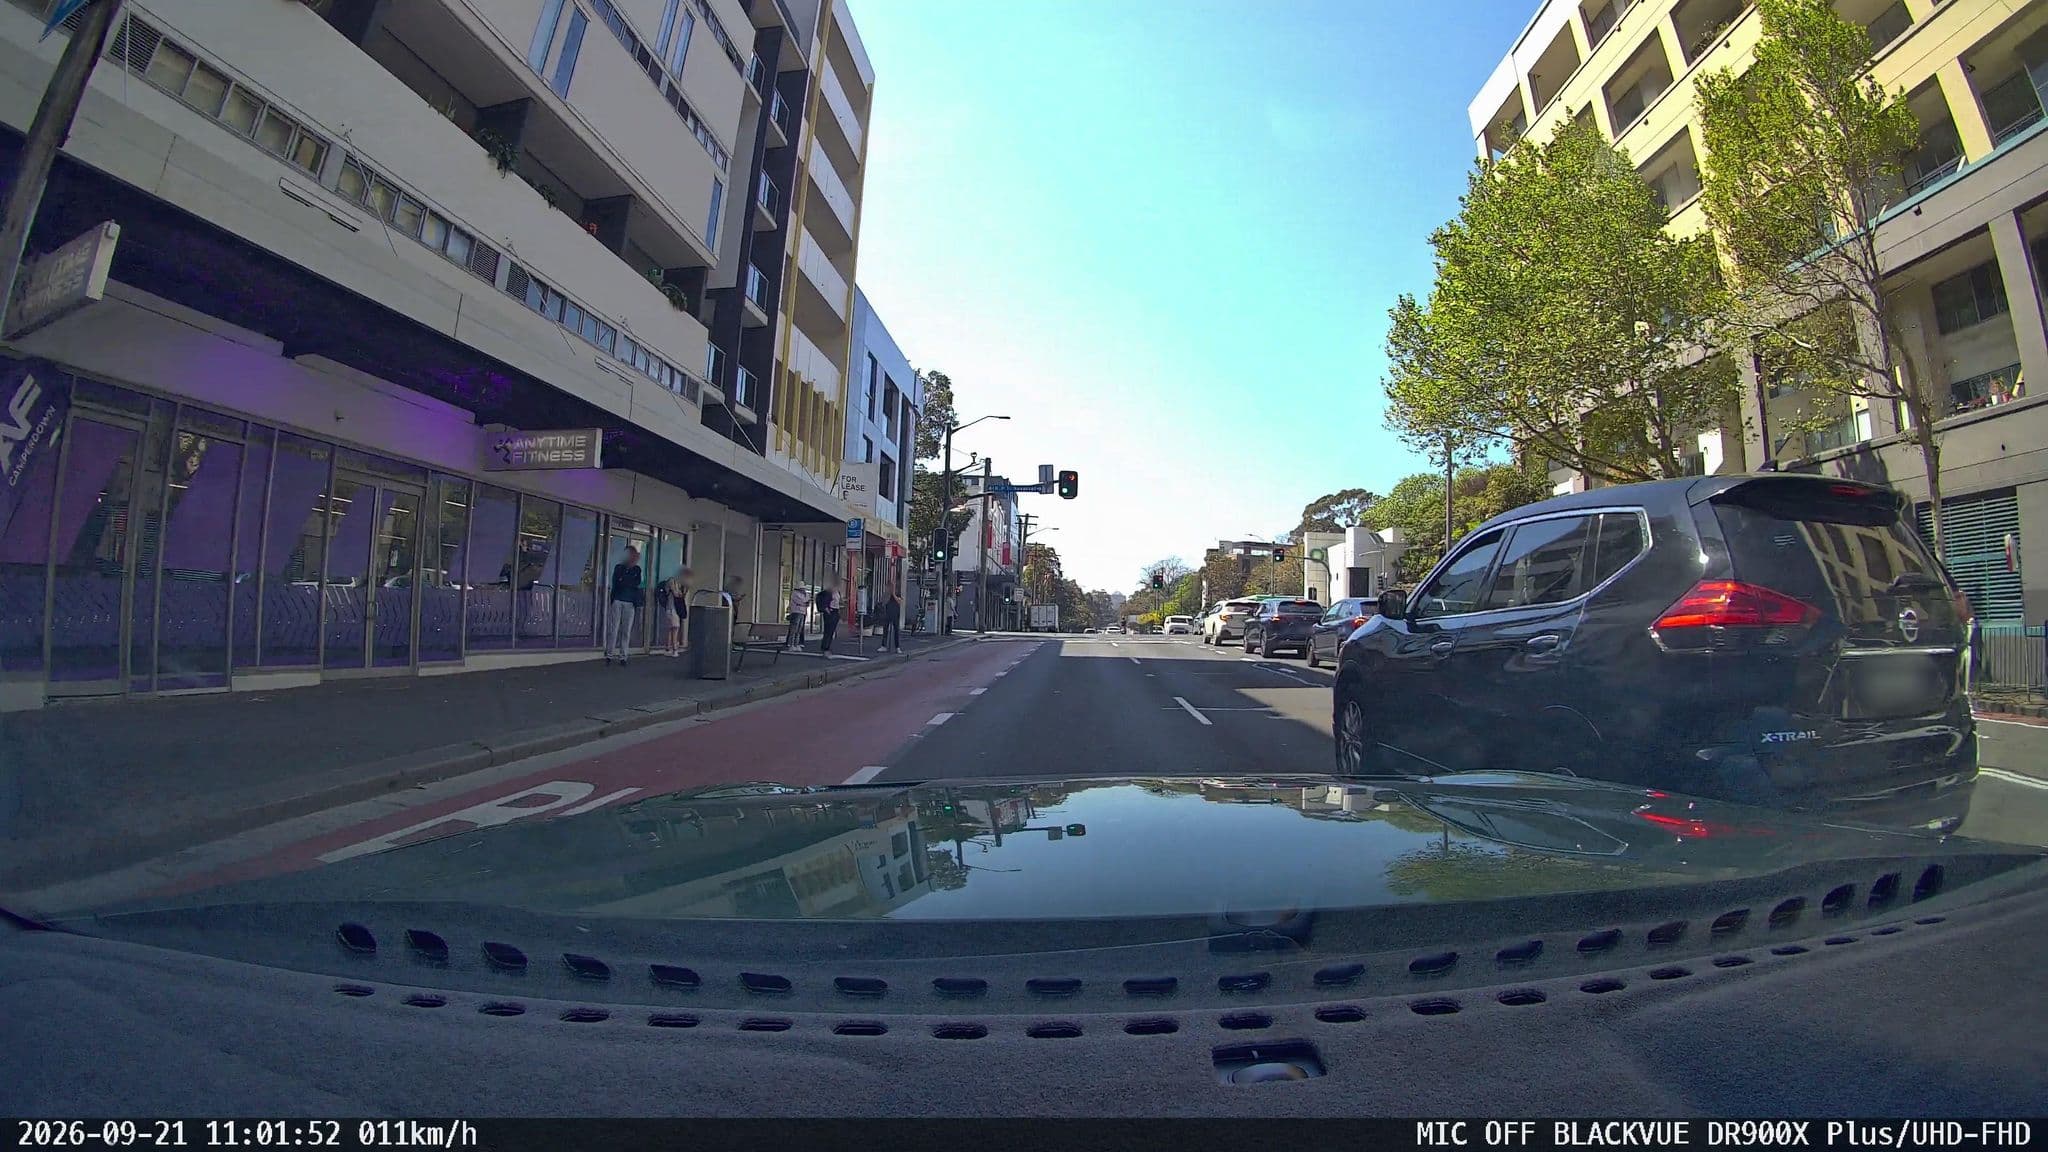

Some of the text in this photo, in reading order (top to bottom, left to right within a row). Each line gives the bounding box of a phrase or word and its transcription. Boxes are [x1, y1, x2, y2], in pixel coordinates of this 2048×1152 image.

[512, 435, 587, 449] ANYTIME
[512, 449, 585, 463] FITNESS
[841, 474, 857, 483] FOR
[841, 482, 865, 492] LEASE
[1761, 730, 1822, 743] X-TRAIL
